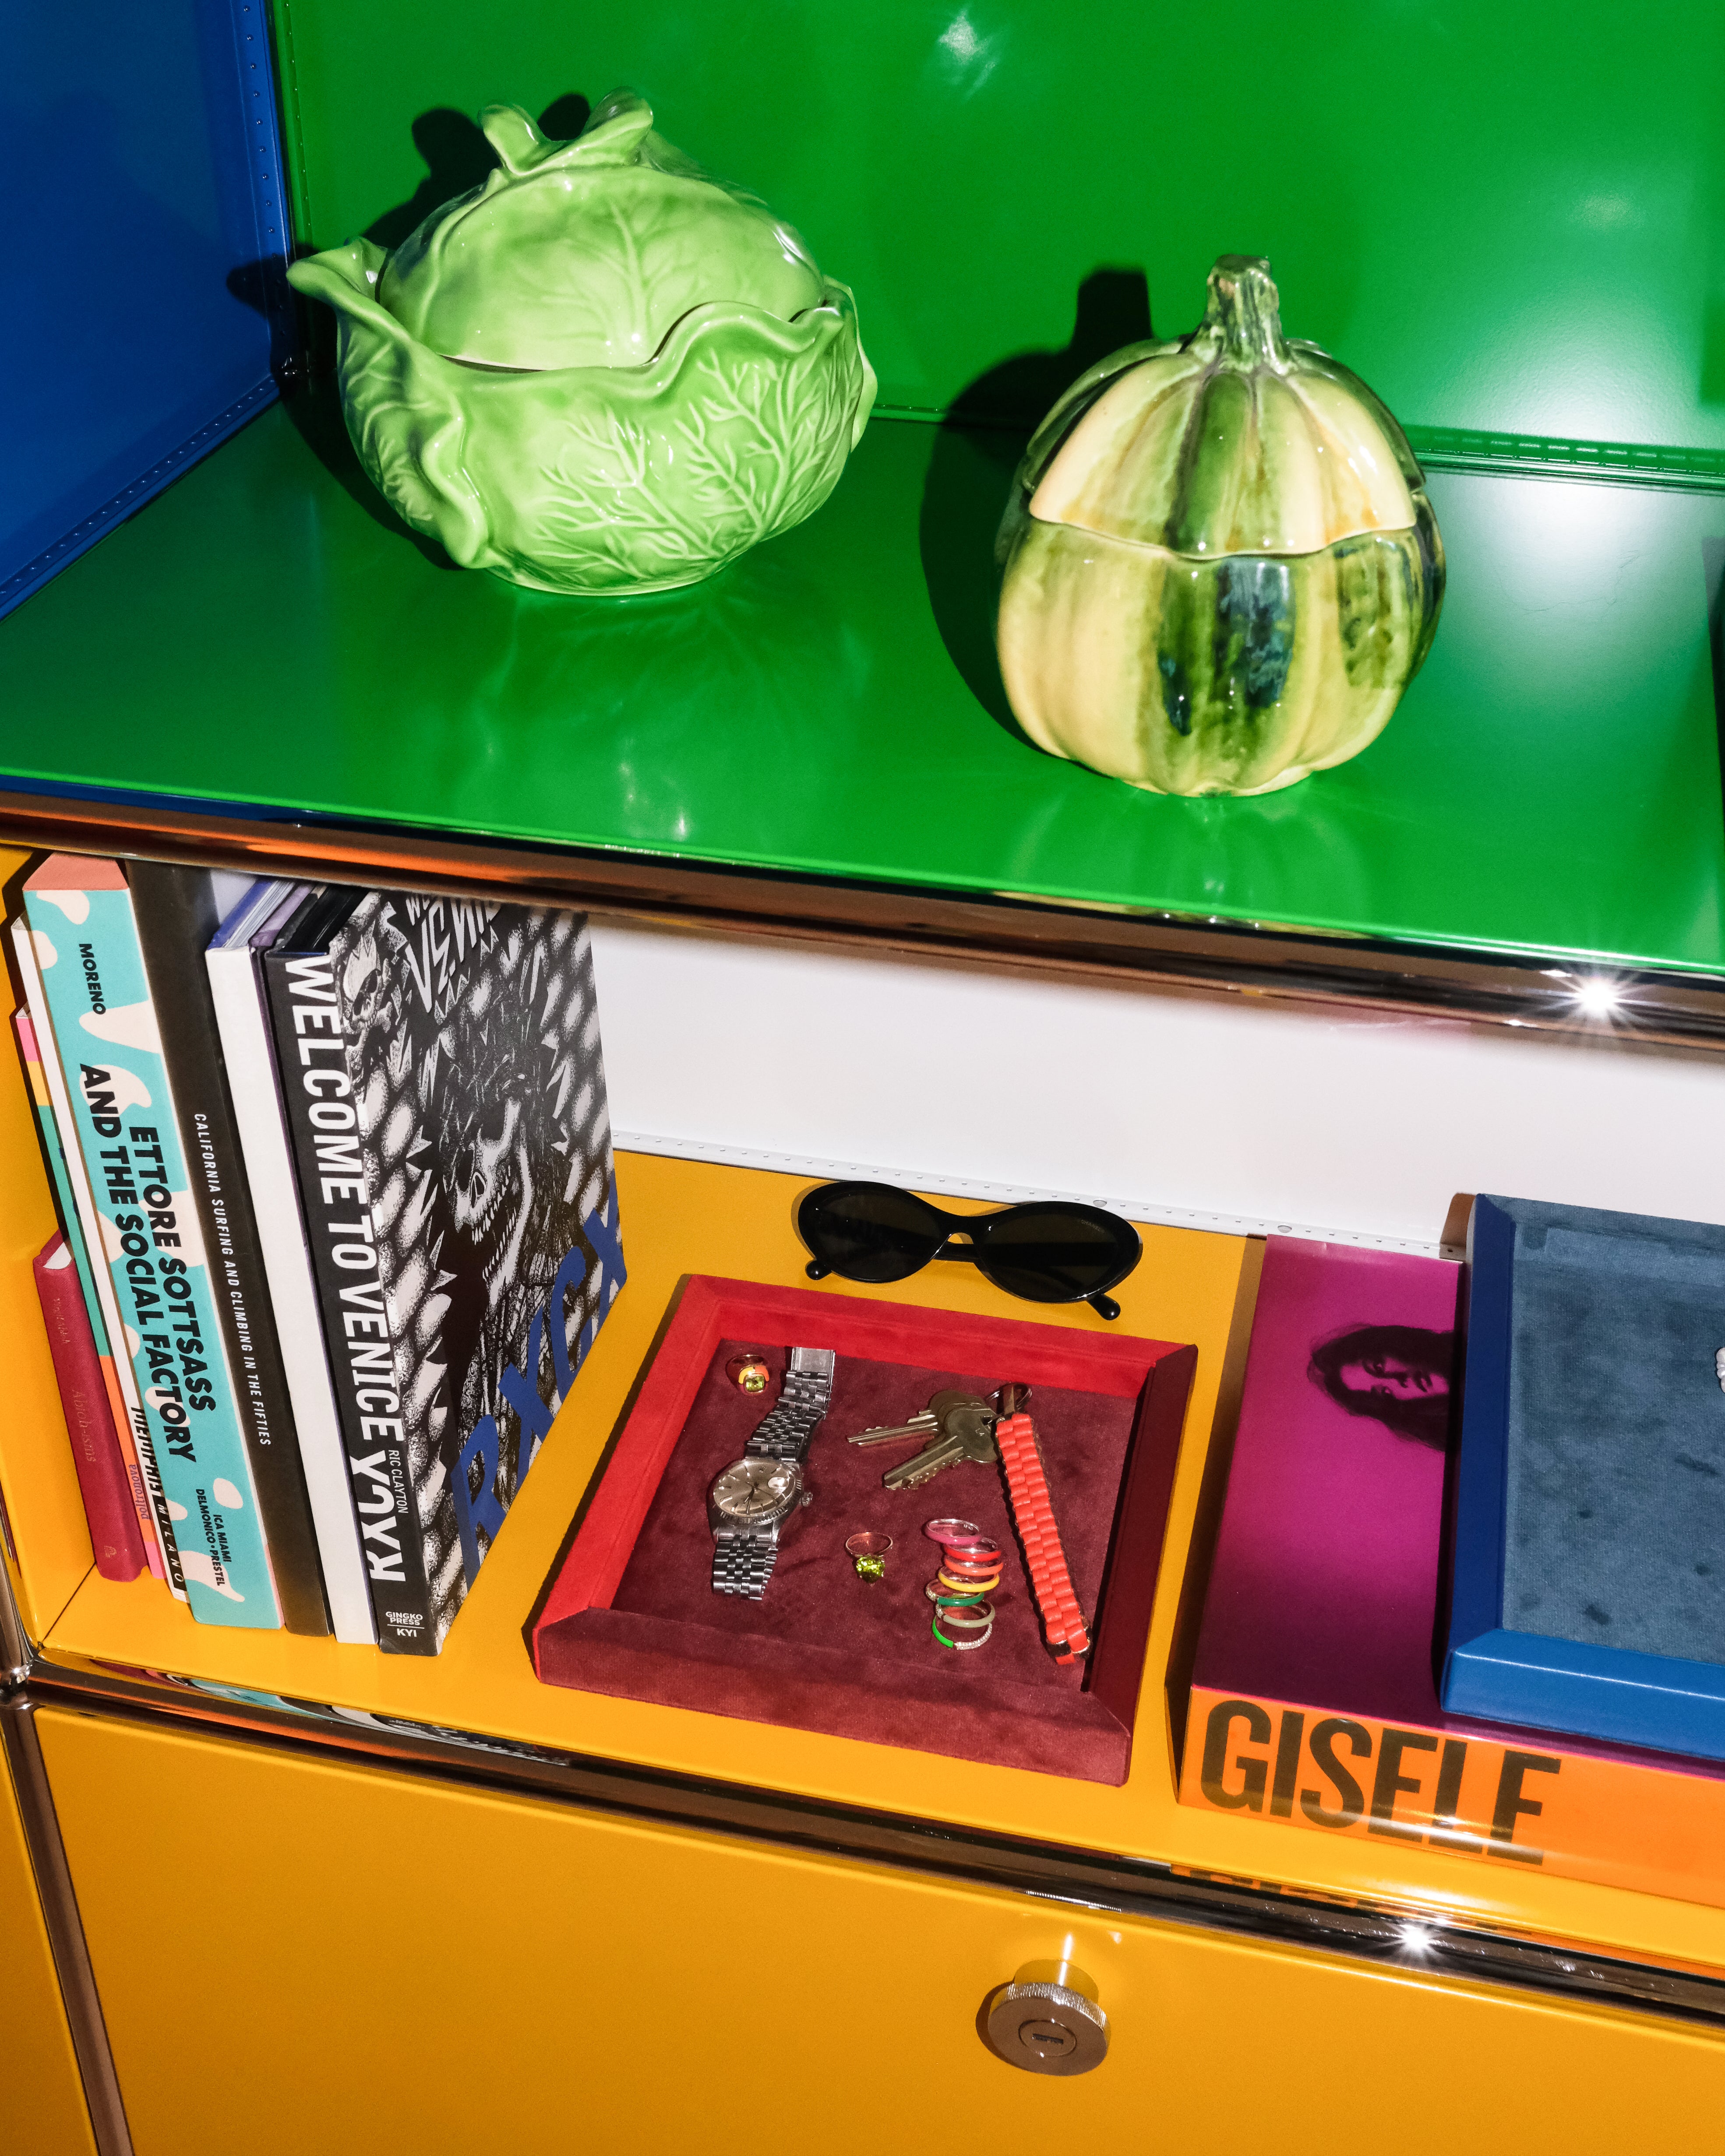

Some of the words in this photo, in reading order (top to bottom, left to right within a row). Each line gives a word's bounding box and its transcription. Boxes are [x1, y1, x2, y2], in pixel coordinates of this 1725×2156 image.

[79, 943, 106, 1015] MORENO
[80, 1063, 122, 1138] AND
[285, 955, 368, 1205] WELCOME
[100, 1146, 139, 1204] THE
[194, 1113, 221, 1192] CALIFORNIA
[212, 1199, 234, 1255] SURFING
[328, 1215, 377, 1269] TO
[115, 1213, 164, 1325] SOCIAL
[129, 1127, 182, 1247] ETTORE
[159, 1257, 216, 1412] SOTTSASS
[224, 1261, 240, 1286] AND
[230, 1291, 253, 1352] CLIMBING
[243, 1356, 256, 1369] IN
[247, 1374, 261, 1397] THE
[339, 1280, 405, 1442] VENICE
[142, 1334, 196, 1463] FACTORY
[252, 1401, 271, 1445] FIFTIES
[388, 1450, 401, 1466] RIC
[128, 1464, 151, 1520] poltronova
[391, 1468, 409, 1514] CLAYTON
[158, 1504, 184, 1582] MILANO
[196, 1489, 216, 1543] DELMONICO
[210, 1550, 225, 1586] PRESTEL
[213, 1514, 225, 1530] ICA
[217, 1532, 232, 1562] MIAMI
[385, 1611, 423, 1621] GINGKO
[390, 1617, 420, 1626] PRESS
[397, 1628, 417, 1638] KYI
[1200, 1699, 1561, 1866] GISELE
